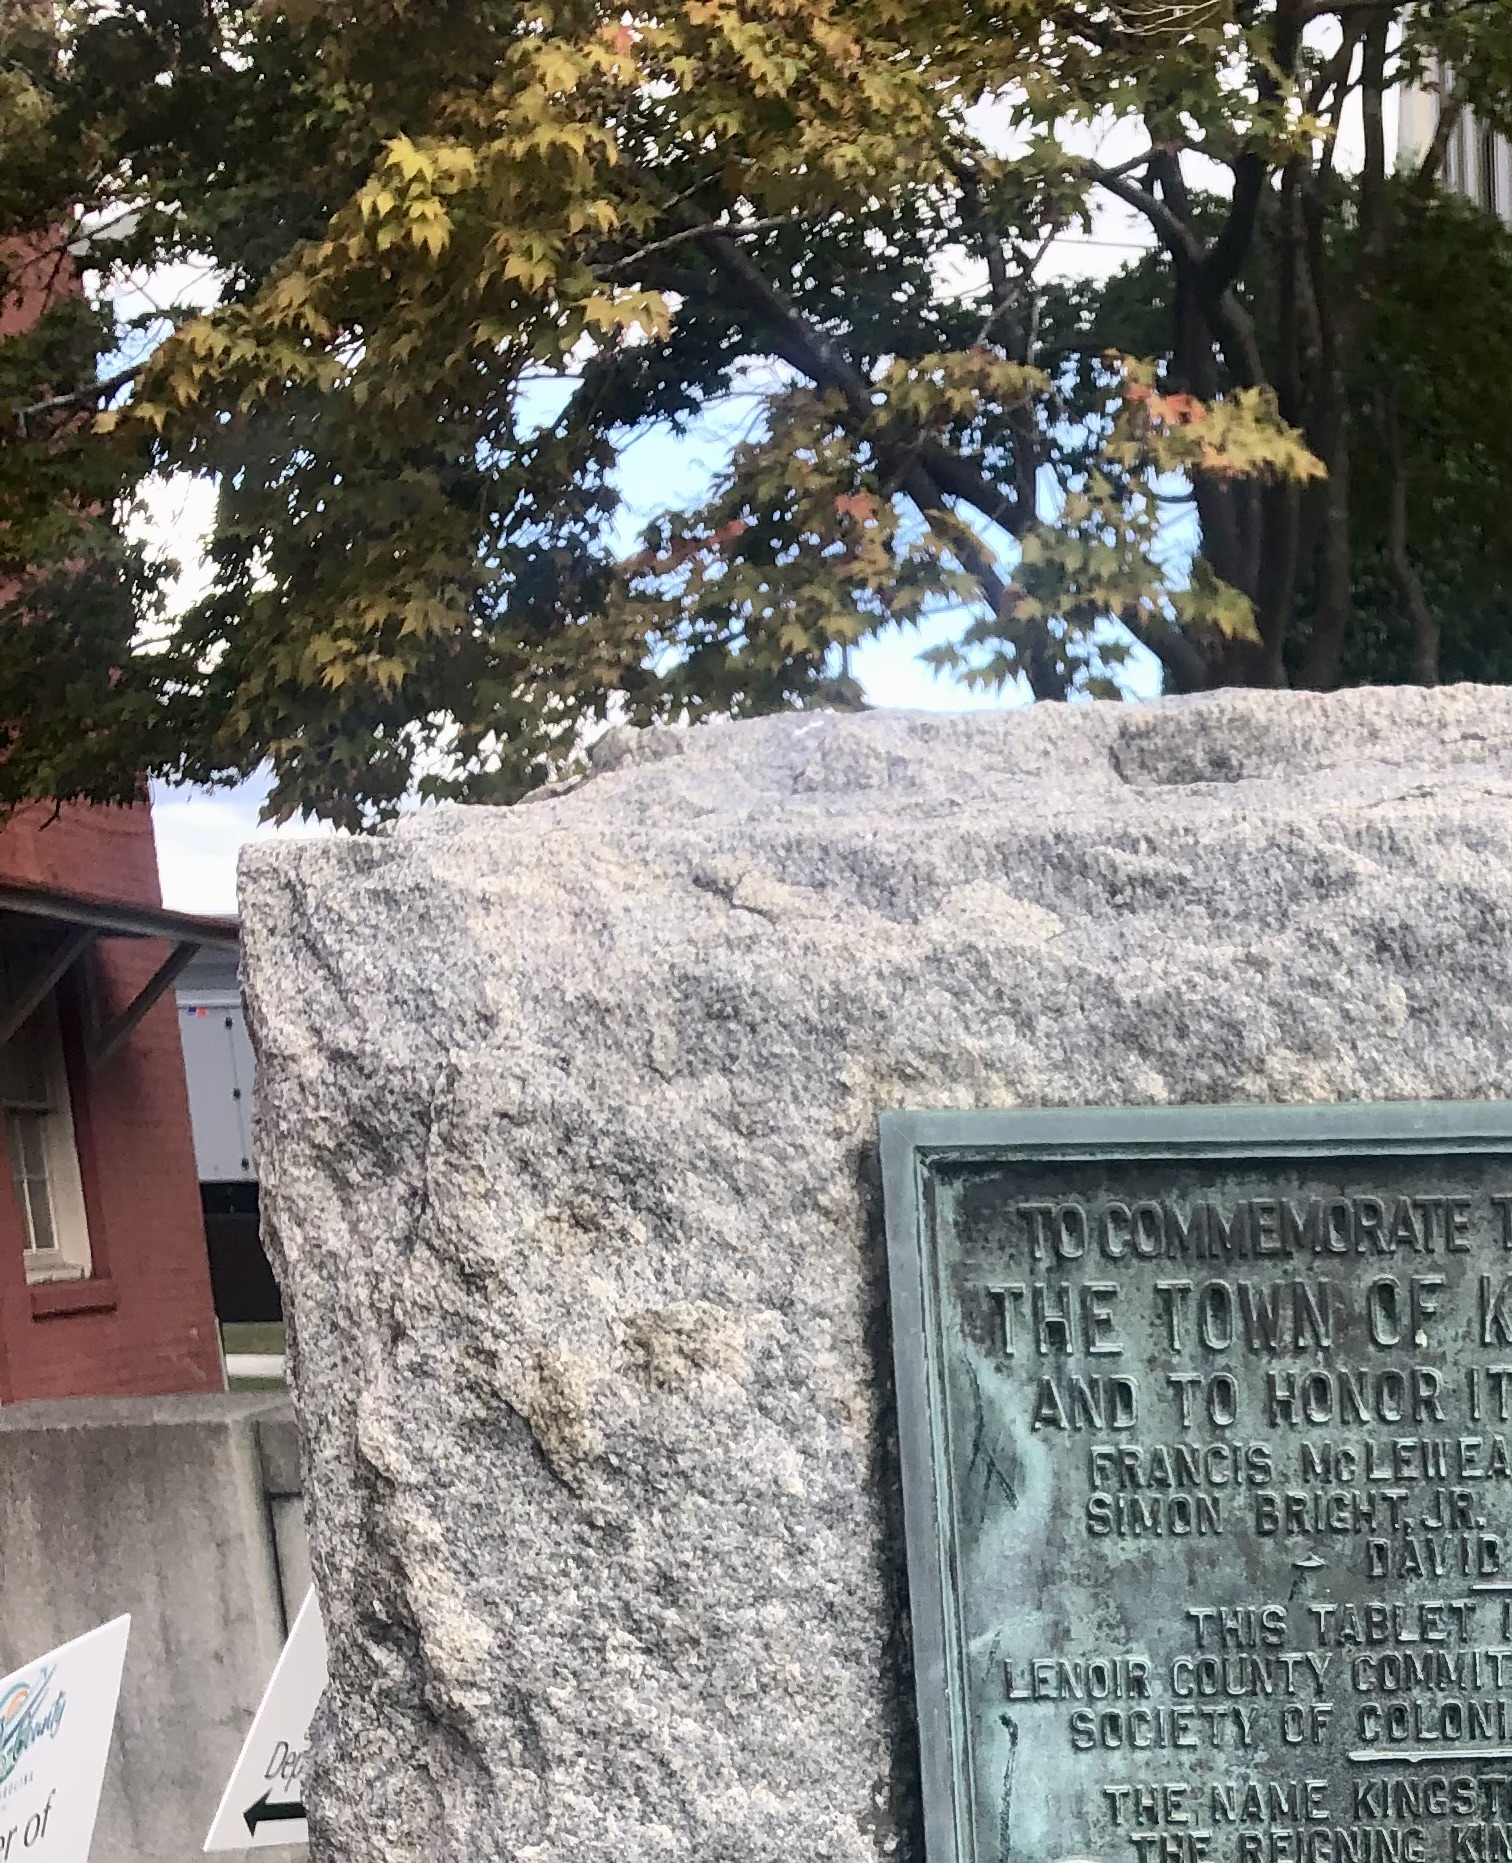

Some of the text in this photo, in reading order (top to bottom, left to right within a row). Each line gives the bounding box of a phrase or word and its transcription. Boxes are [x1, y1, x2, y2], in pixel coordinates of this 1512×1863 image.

[1016, 1201, 1088, 1258] TO
[1105, 1195, 1472, 1258] COMMEMORATE
[988, 1281, 1124, 1355] THE
[1156, 1276, 1331, 1353] TOWN
[1369, 1274, 1446, 1346] OF
[1032, 1373, 1139, 1431] AND
[1167, 1370, 1239, 1427] TO
[1267, 1366, 1445, 1427] HONOR
[1089, 1440, 1274, 1489] FRANCIS
[1086, 1492, 1224, 1537] SIMON
[1256, 1489, 1413, 1537] BRIGHT,
[1423, 1488, 1488, 1531] JR.
[1367, 1533, 1501, 1578] DAVID
[1186, 1604, 1288, 1648] THIS
[1310, 1601, 1476, 1646] TABLET
[1003, 1655, 1152, 1700] LENOIR
[1172, 1651, 1331, 1698] COUNTY
[1070, 1706, 1263, 1750] SOCIETY
[1282, 1703, 1333, 1745] OF
[24, 1788, 56, 1848] of
[1102, 1782, 1189, 1826] THE
[1211, 1778, 1330, 1823] NAME
